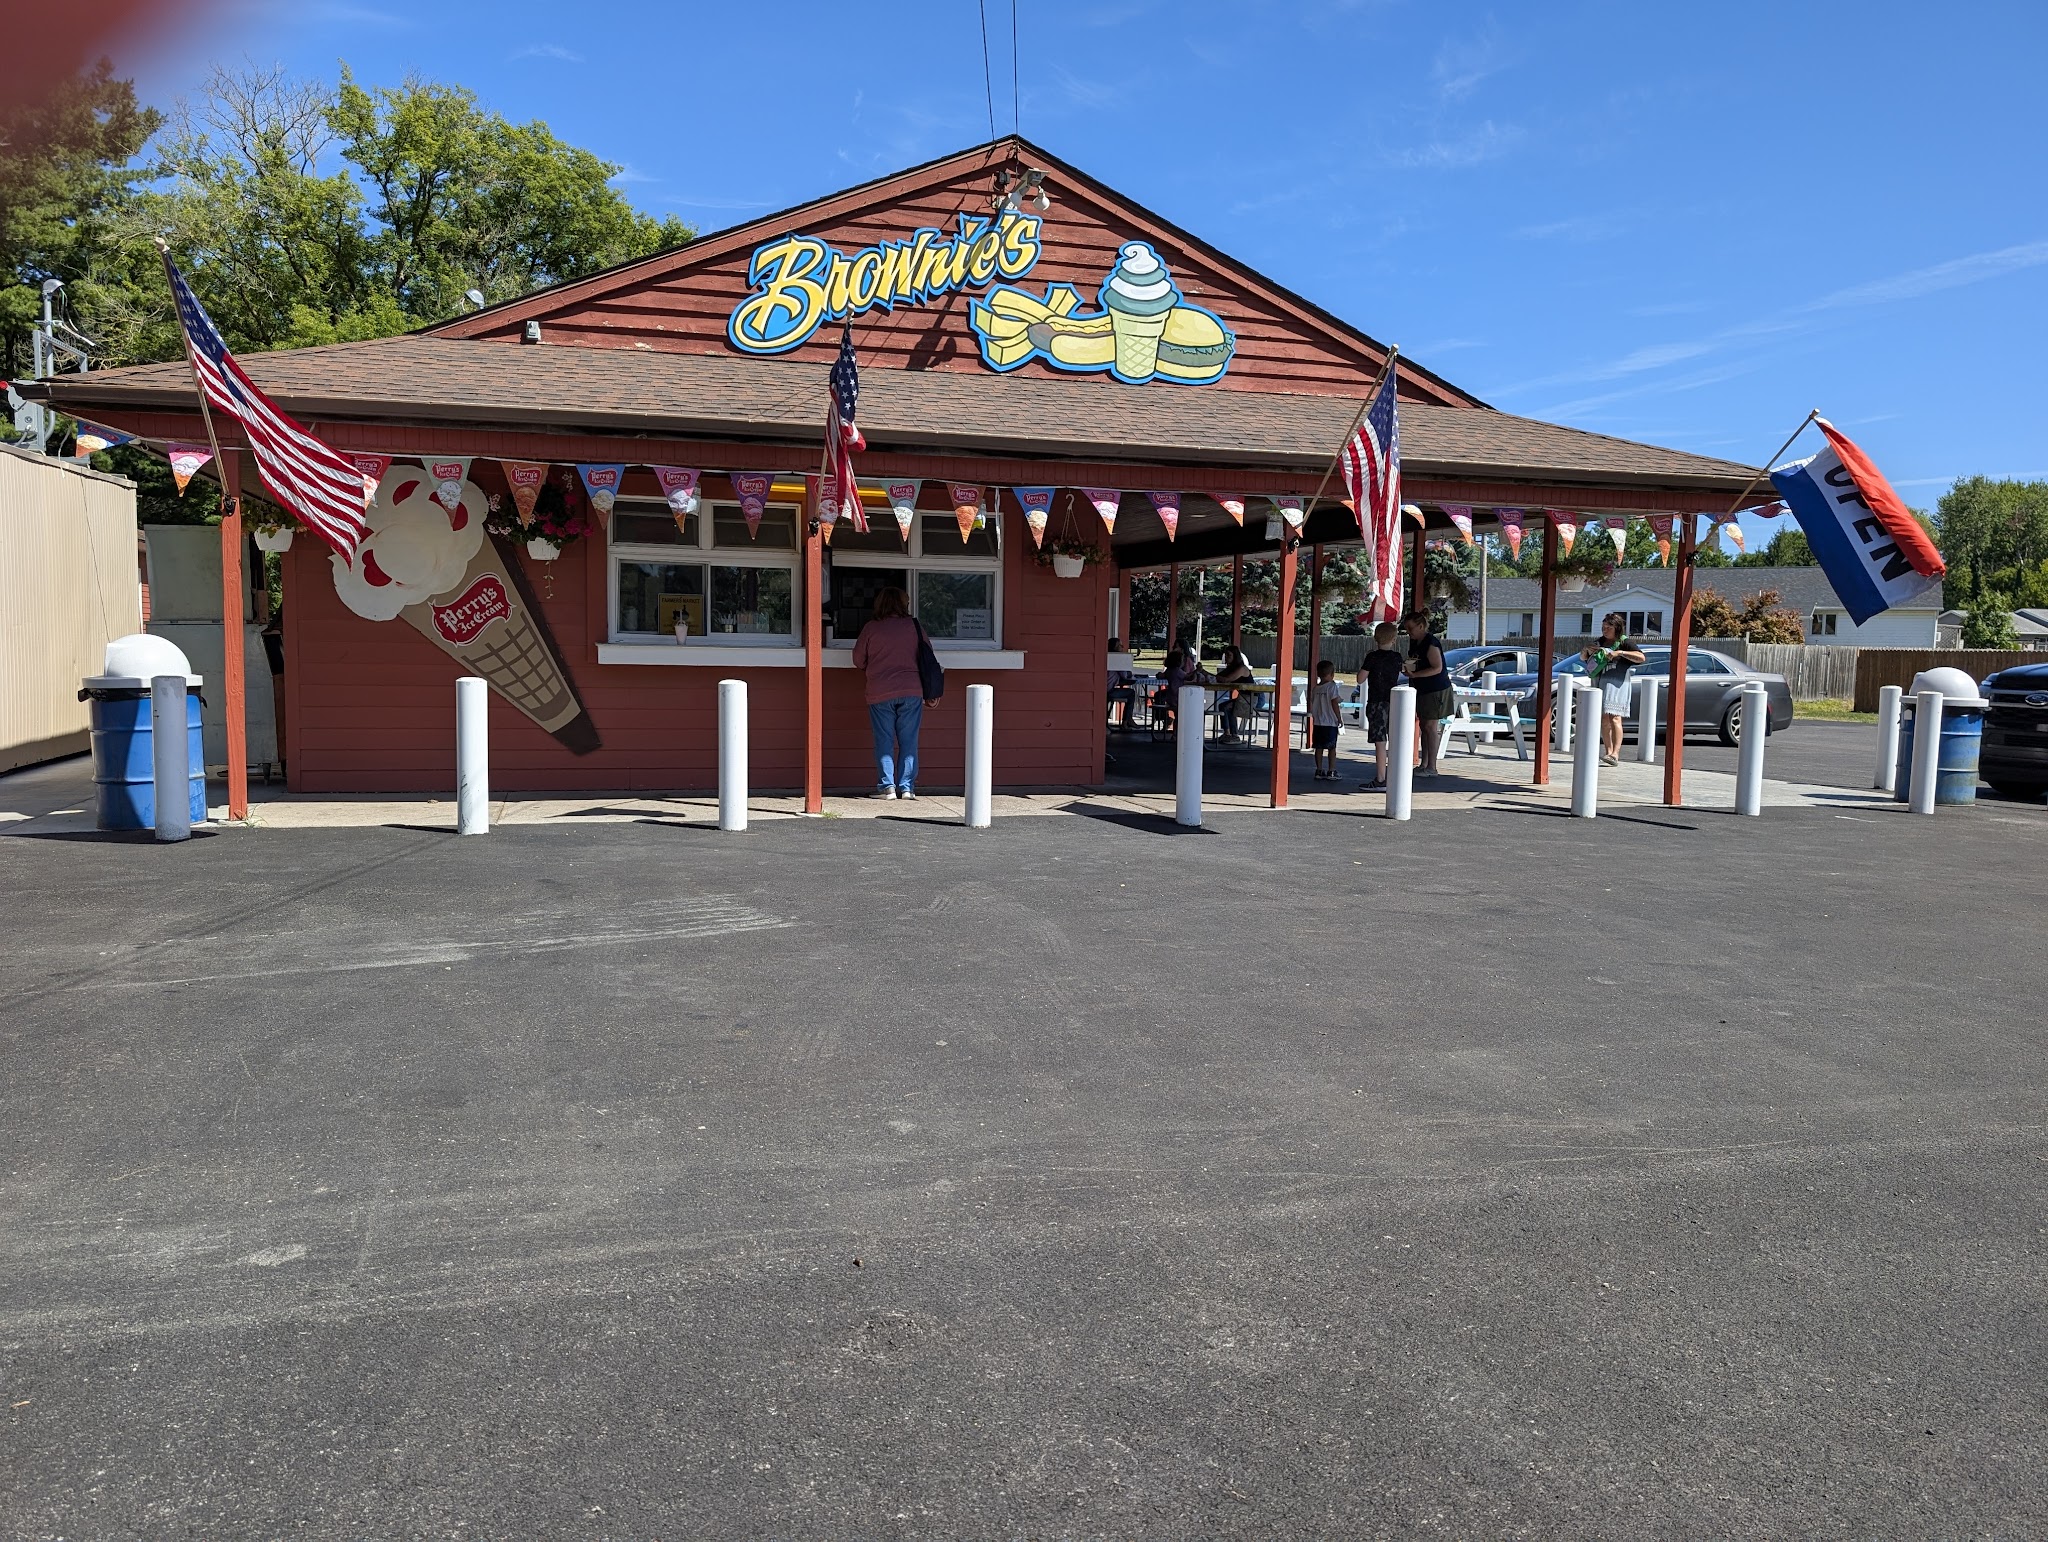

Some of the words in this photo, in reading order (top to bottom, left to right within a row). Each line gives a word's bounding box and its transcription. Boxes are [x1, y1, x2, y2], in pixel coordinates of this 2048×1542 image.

[731, 212, 1040, 350] Brownie's
[436, 465, 460, 474] Perry's
[515, 470, 538, 479] Perry's
[591, 472, 614, 481] Perry's
[666, 472, 689, 482] Perry's
[741, 480, 764, 490] Perry's
[439, 587, 498, 634] Perry's
[457, 620, 476, 634] Ice
[473, 601, 504, 623] Cream
